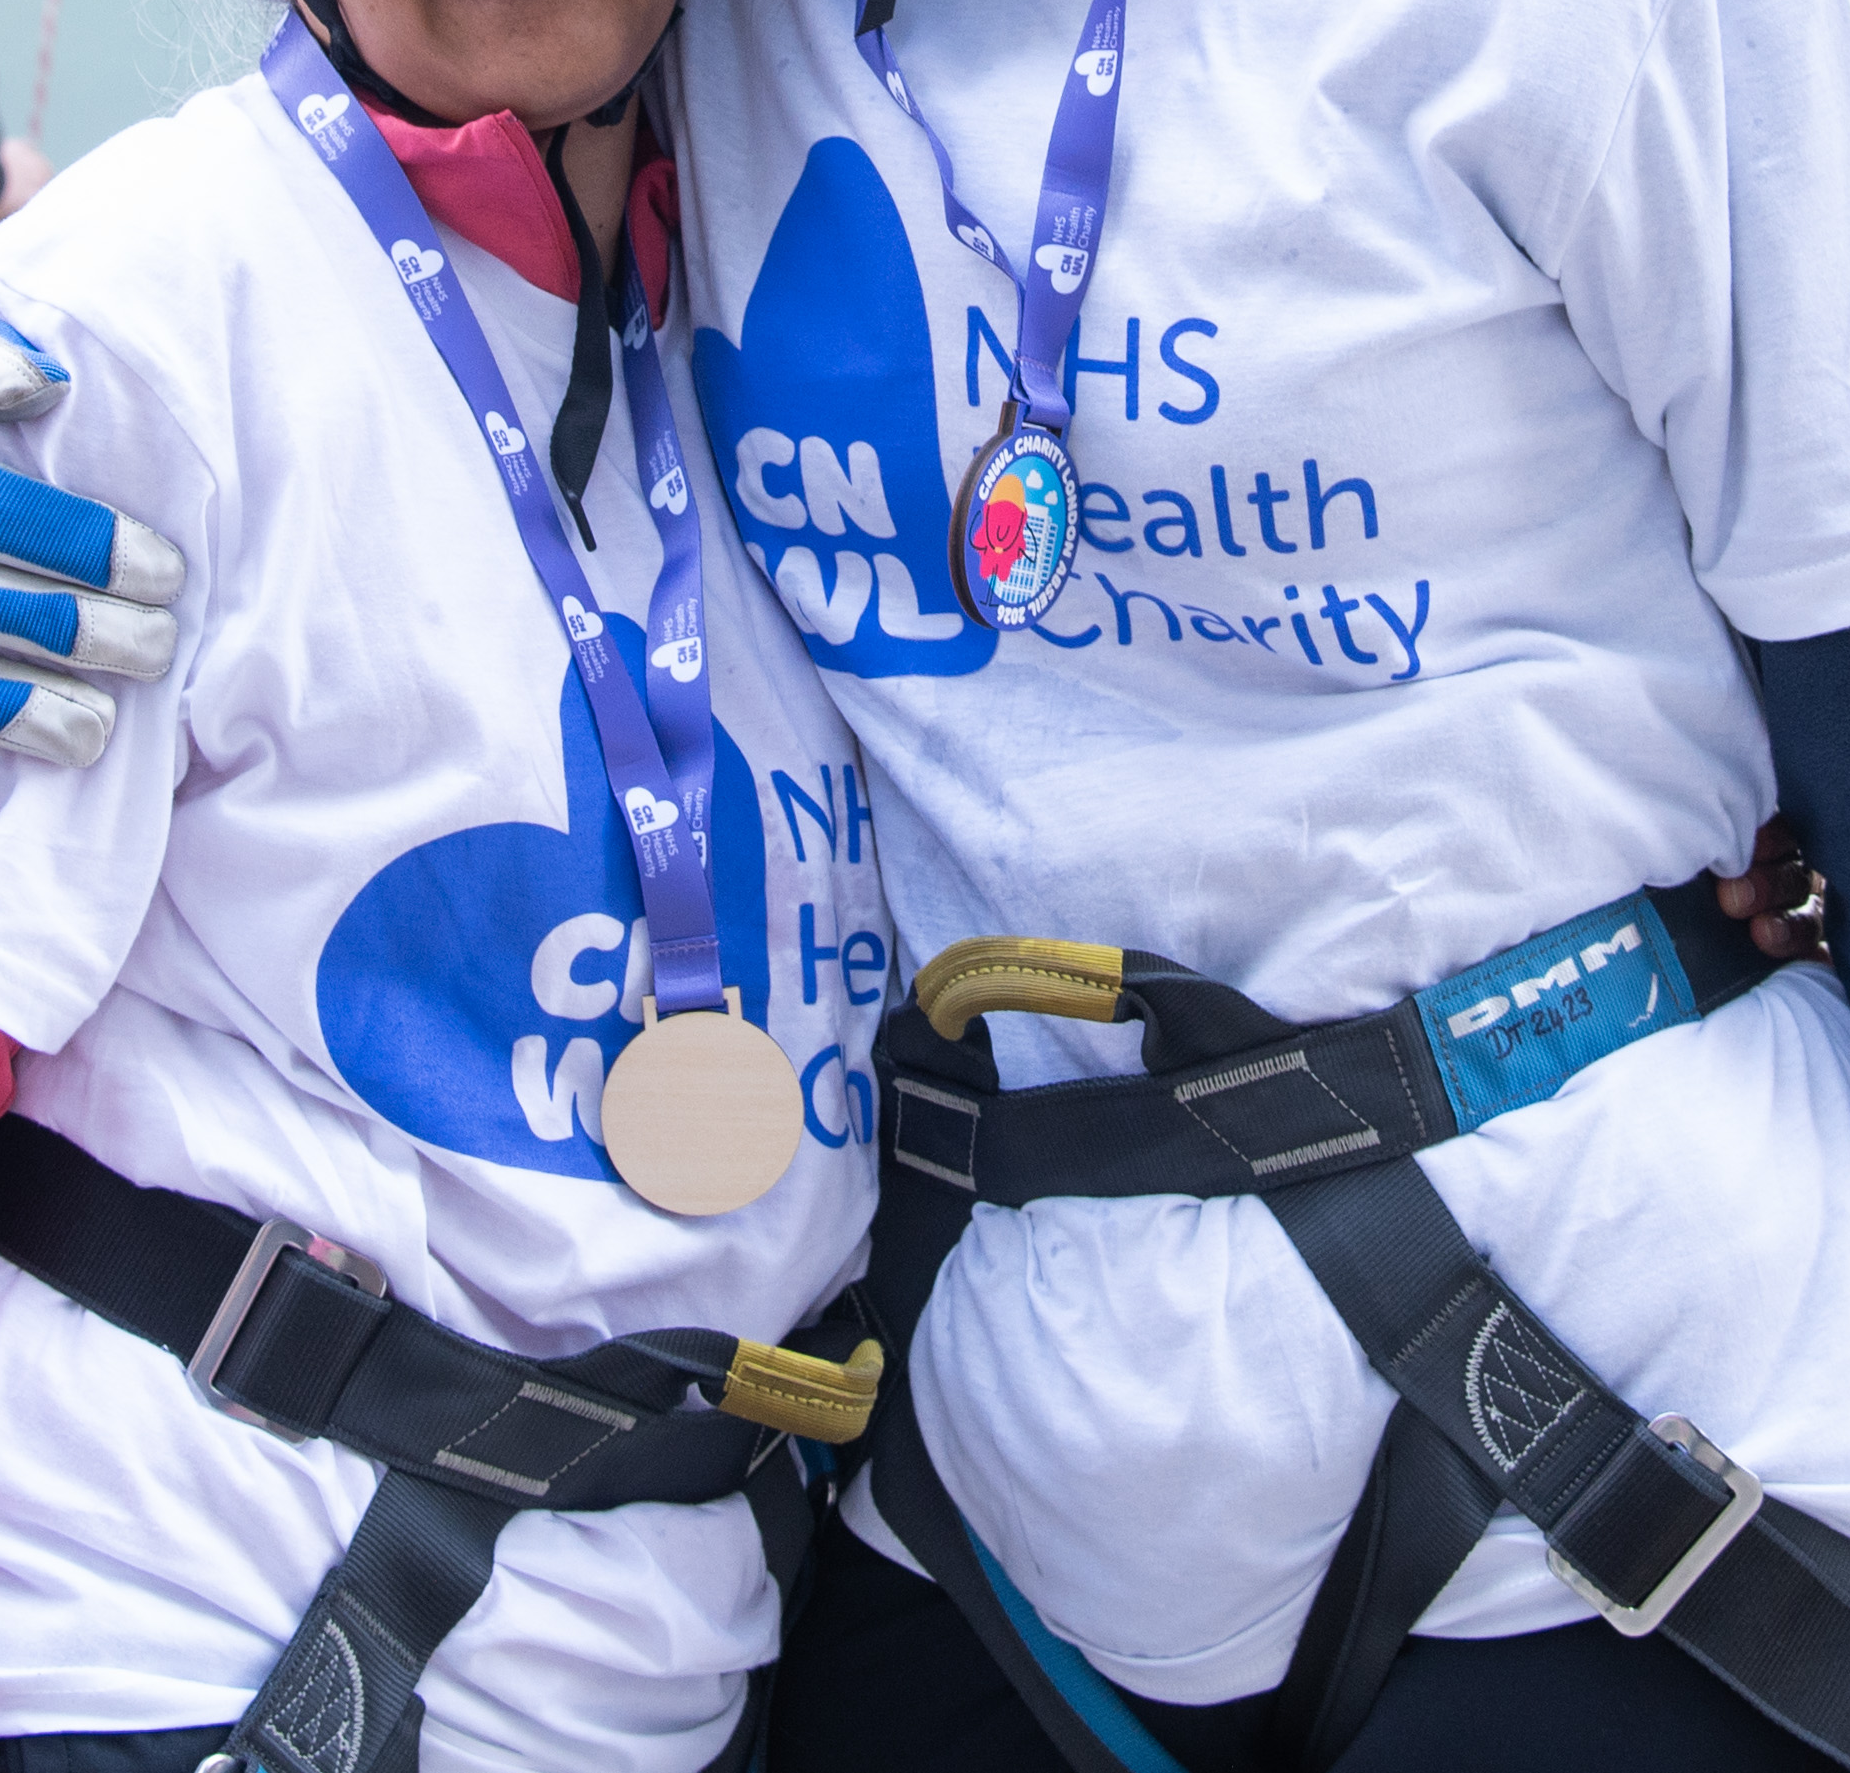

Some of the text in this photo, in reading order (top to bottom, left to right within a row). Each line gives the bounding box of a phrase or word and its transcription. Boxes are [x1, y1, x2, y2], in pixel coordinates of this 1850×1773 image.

[1092, 22, 1104, 49] NHS
[1052, 215, 1067, 243] NHS
[1065, 206, 1081, 246] Health
[1077, 205, 1098, 249] Charity
[1061, 254, 1073, 274] CN
[1071, 253, 1086, 276] WL
[410, 283, 434, 322] Charity
[420, 280, 442, 316] Health
[430, 276, 449, 303] NHS
[965, 304, 1221, 426] NHS
[517, 453, 532, 478] NHS
[735, 426, 898, 539] CN
[1074, 459, 1380, 558] ealth
[978, 435, 1079, 626] CNWL CHARITY LONDON ABSEIL 2026
[577, 642, 597, 684] Charity
[585, 640, 604, 678] Health
[594, 638, 610, 665] NHS
[631, 807, 647, 831] WL
[642, 805, 655, 824] CN
[692, 786, 708, 830] Charity
[639, 834, 656, 879] Charity
[651, 831, 668, 873] Health
[663, 828, 679, 856] NHS
[1447, 922, 1643, 1040] DMM
